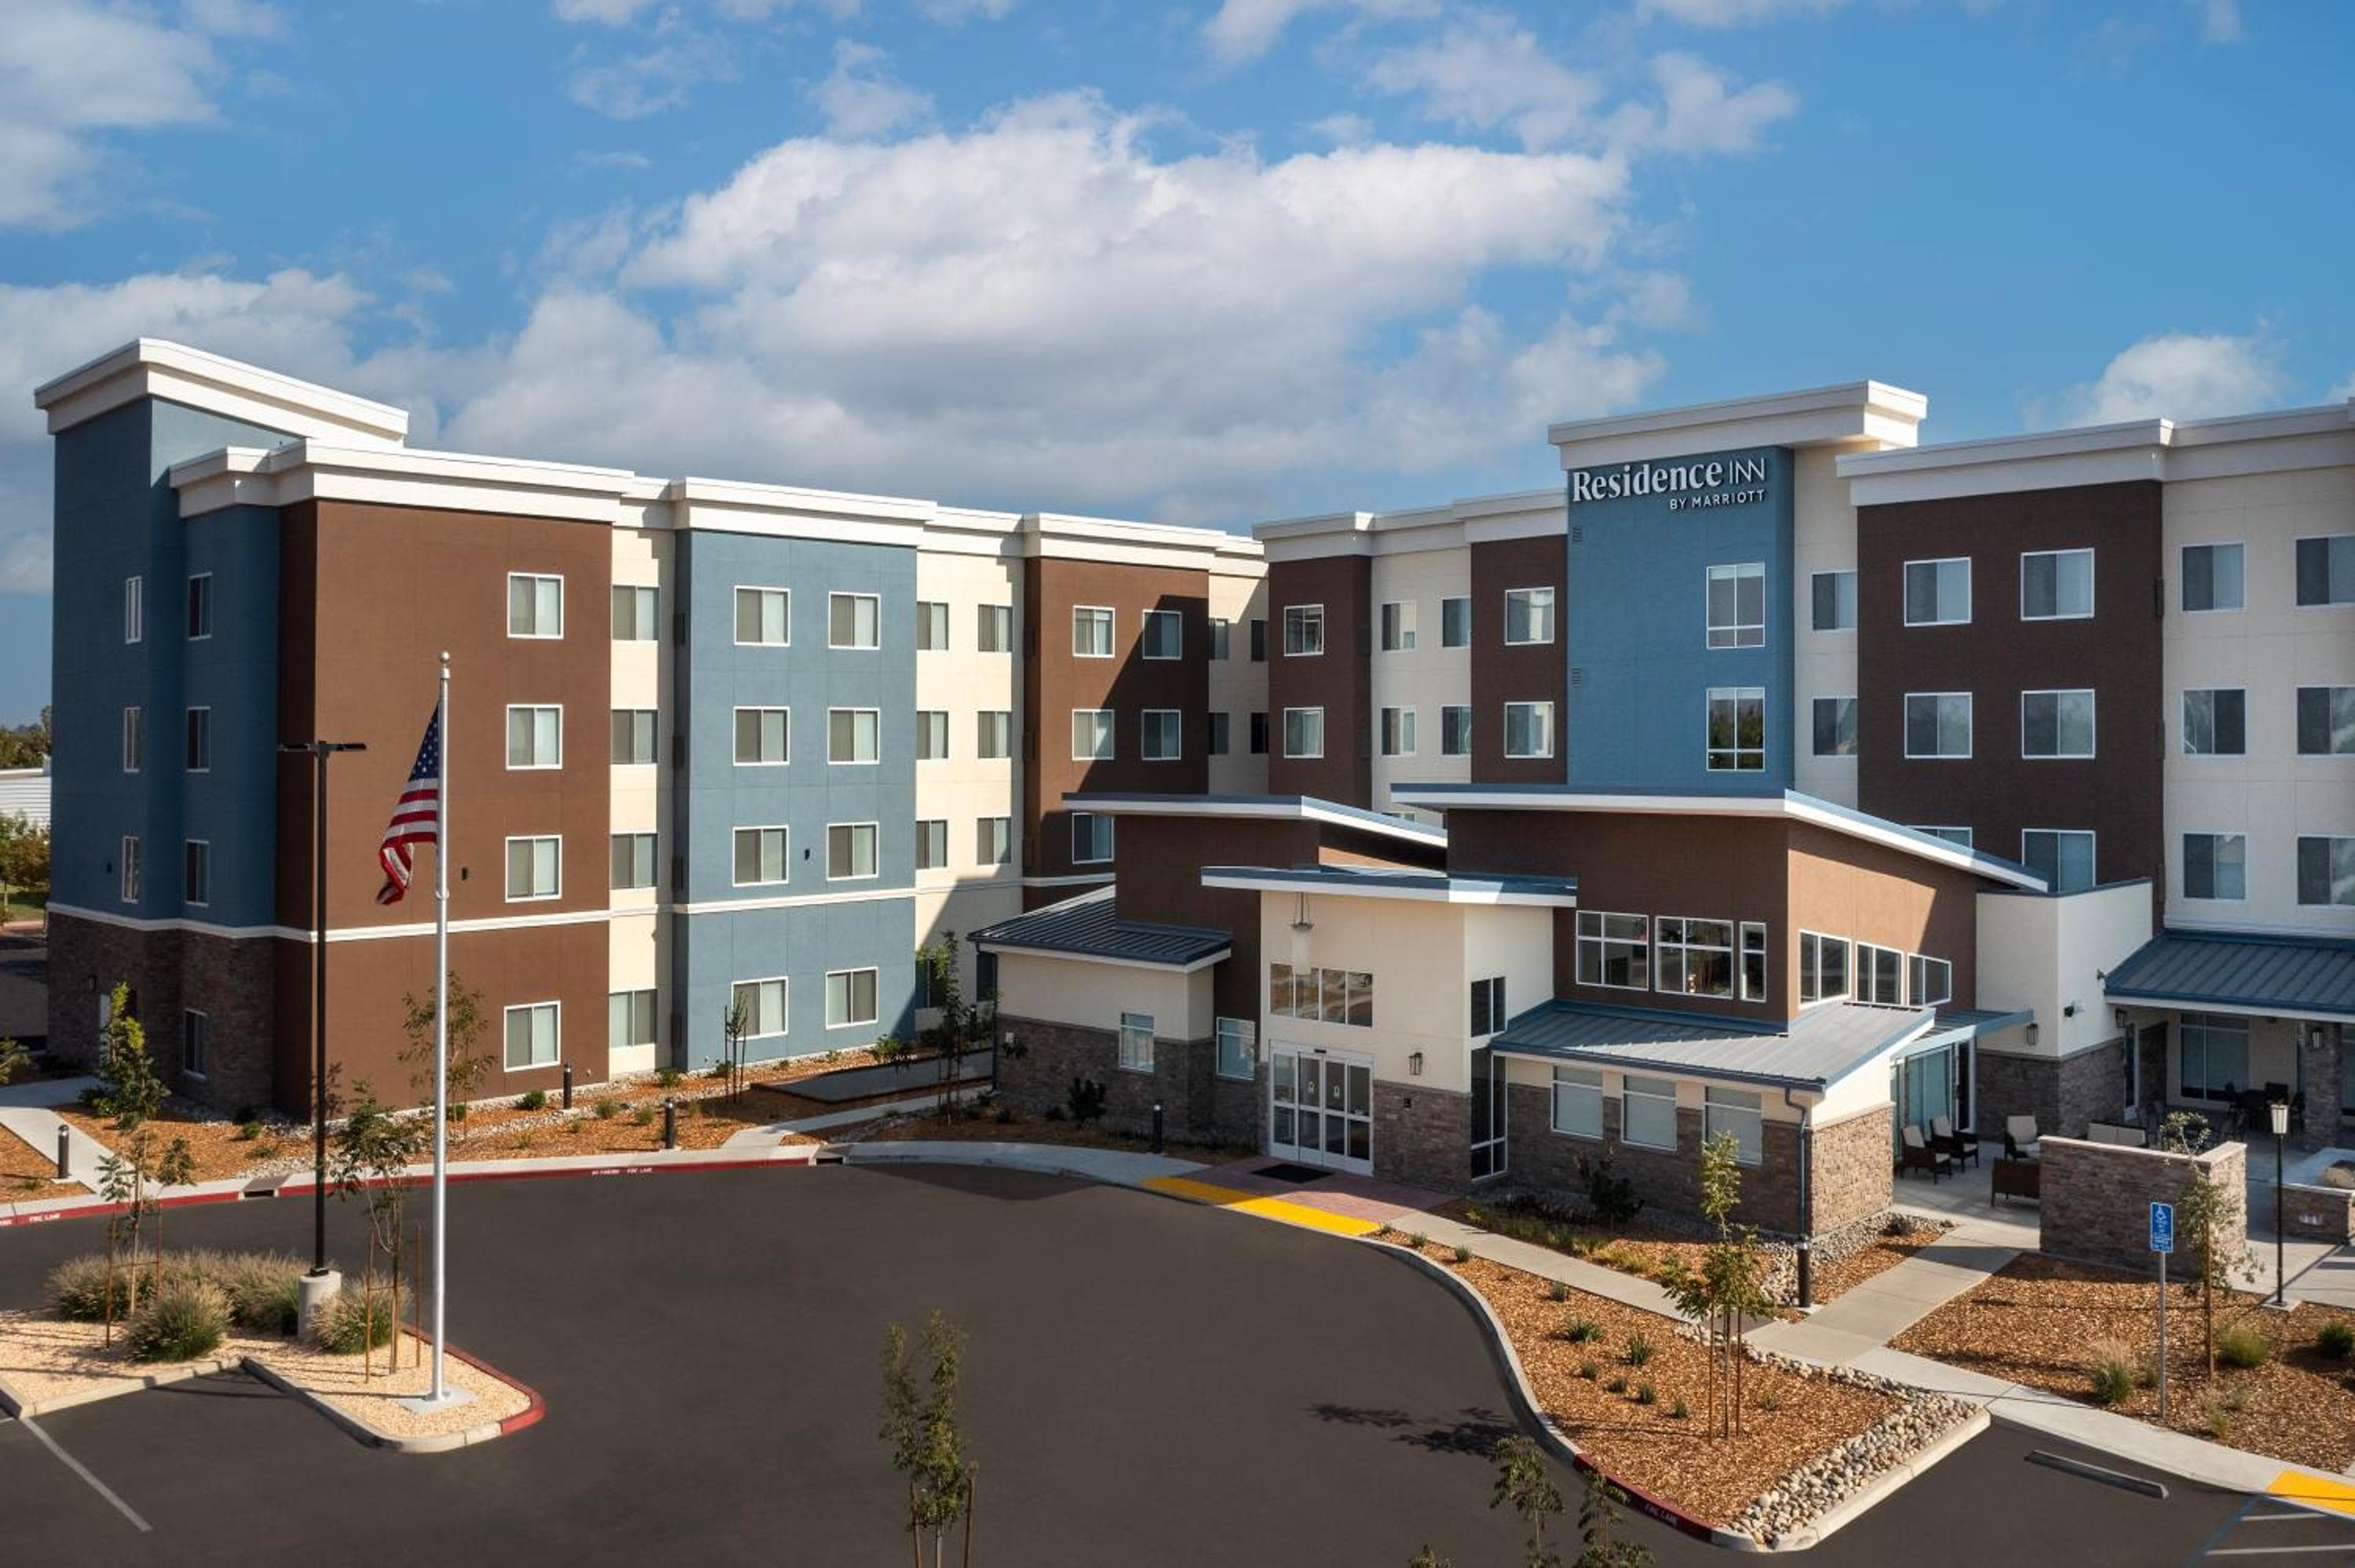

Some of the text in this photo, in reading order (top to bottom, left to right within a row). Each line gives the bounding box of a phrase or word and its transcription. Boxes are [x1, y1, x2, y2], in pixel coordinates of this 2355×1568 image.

[1572, 458, 1765, 501] Residence INN
[1670, 489, 1765, 510] BY MARRIOTT
